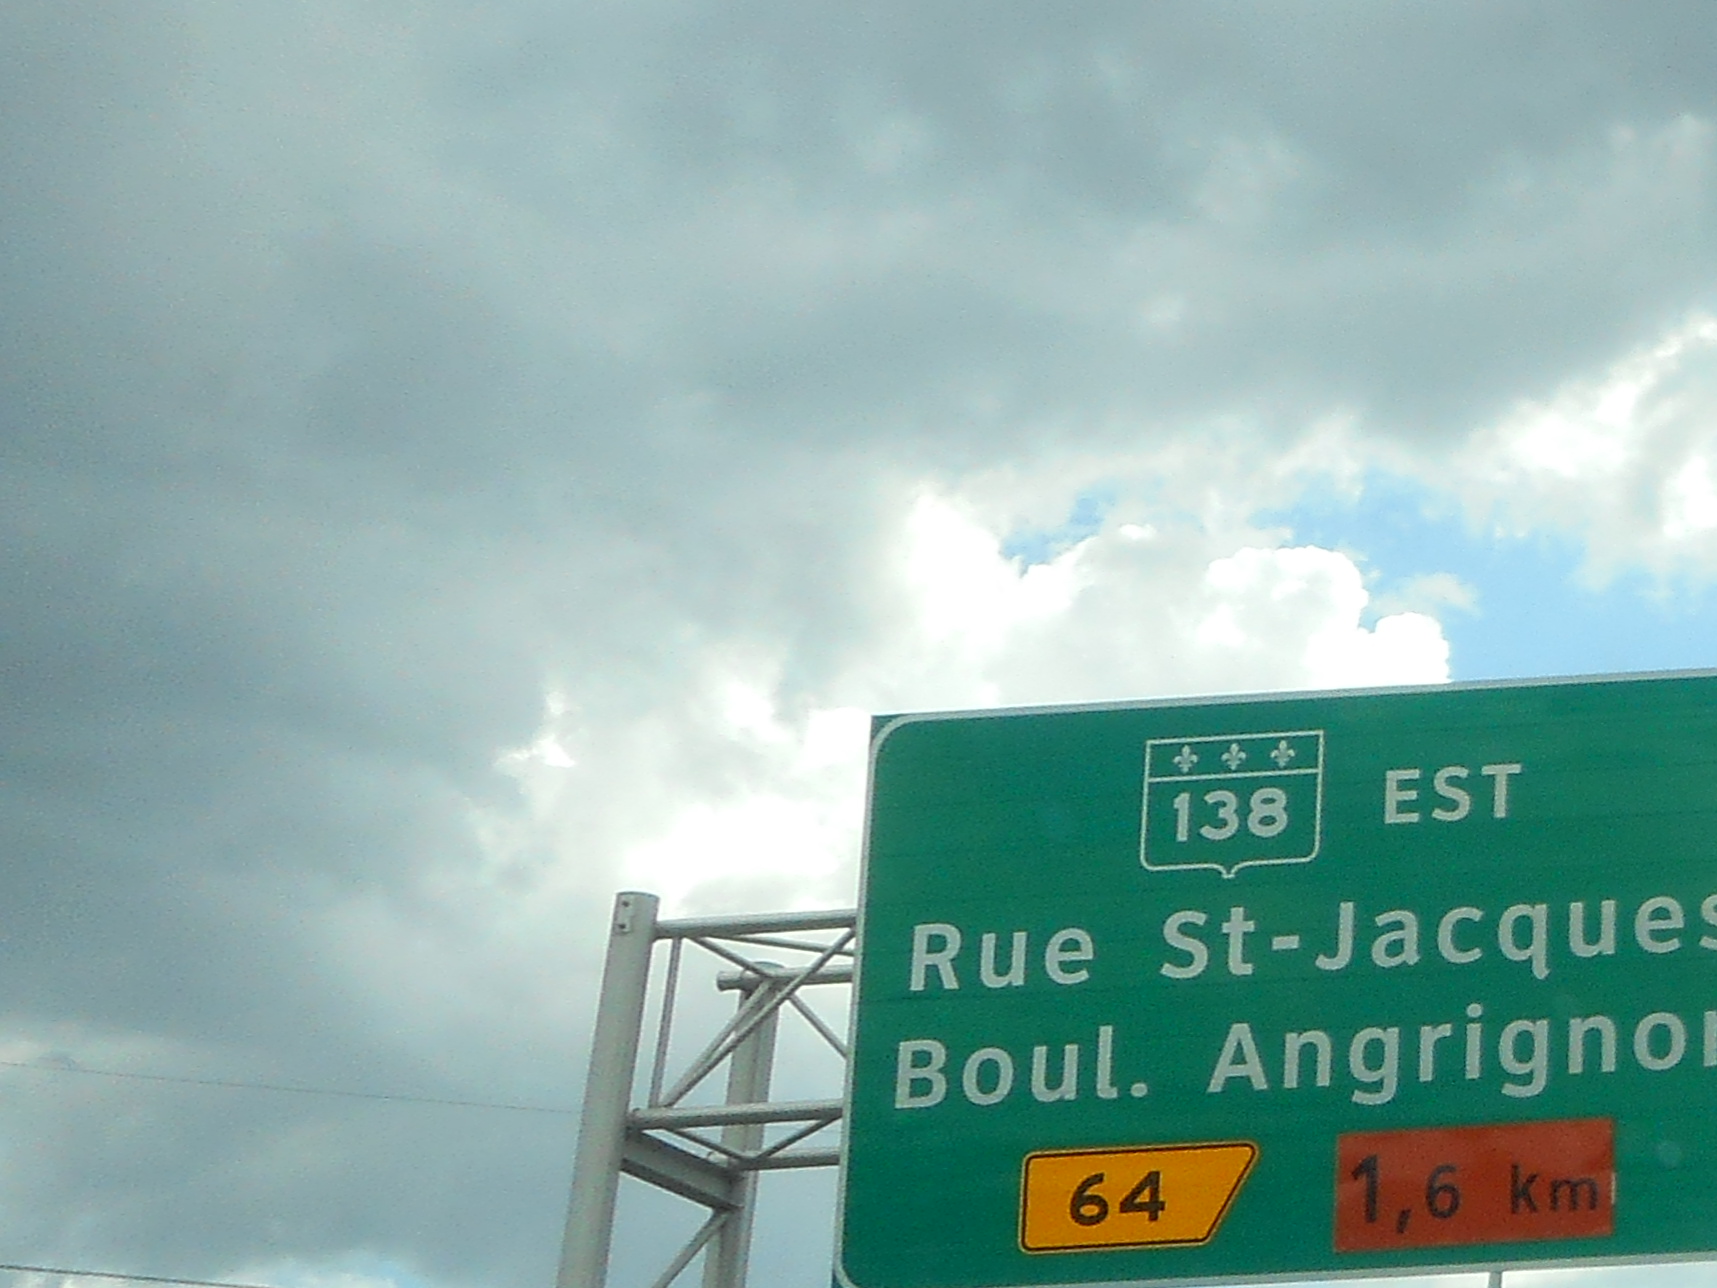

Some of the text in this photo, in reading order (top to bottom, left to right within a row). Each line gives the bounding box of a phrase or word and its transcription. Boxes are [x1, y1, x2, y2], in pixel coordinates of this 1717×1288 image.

[1172, 764, 1522, 843] 138 EST
[909, 922, 1094, 992] Rue
[895, 1025, 1148, 1110] Boul.
[1068, 1170, 1166, 1225] 64
[1351, 1155, 1601, 1234] 1,6 km
